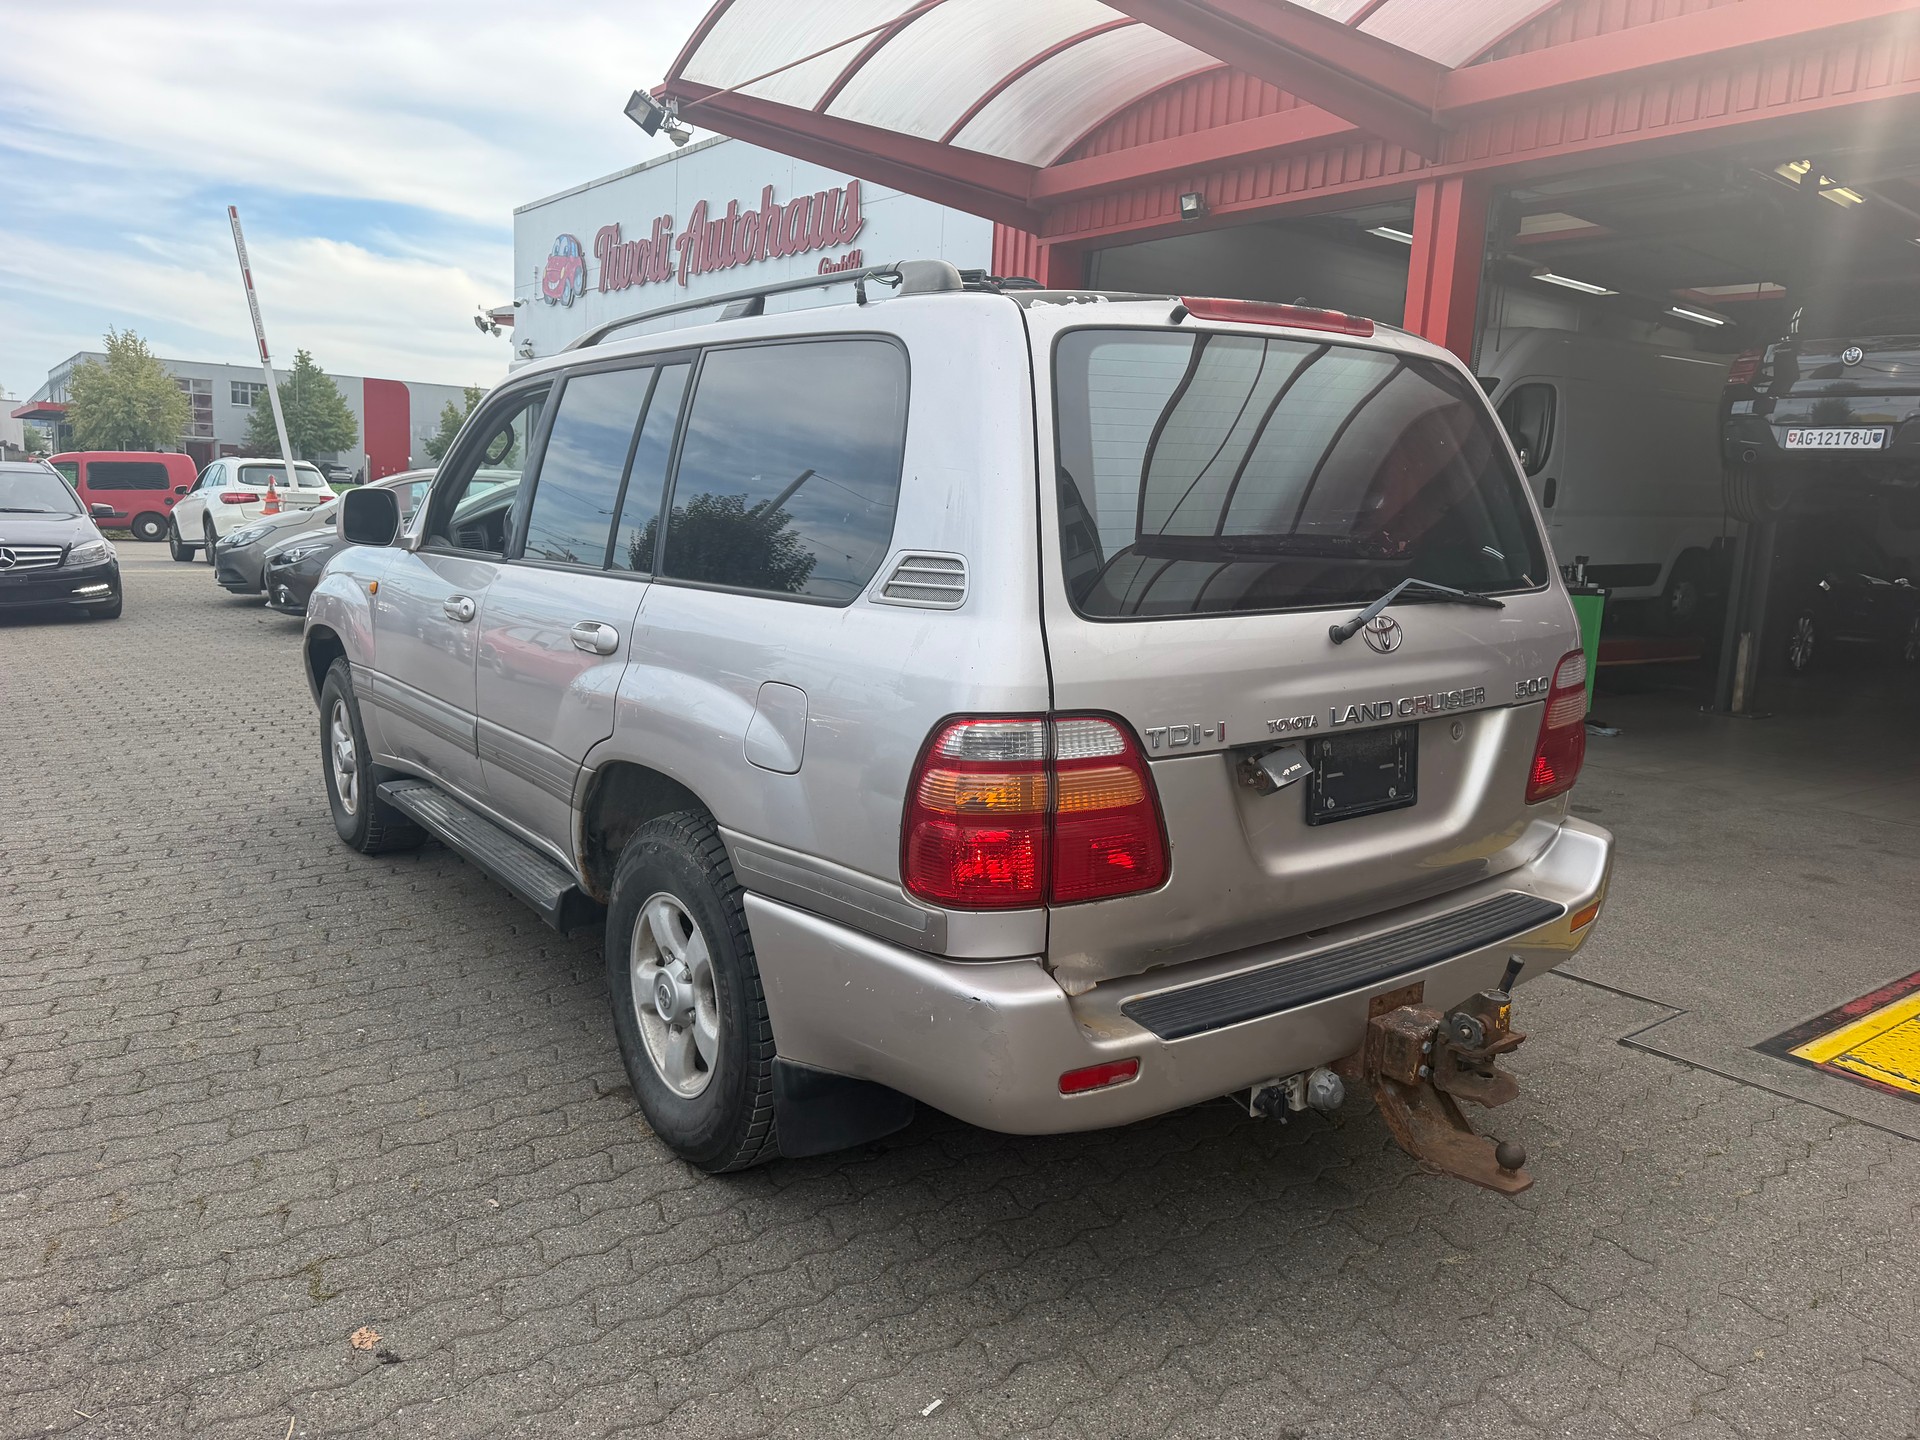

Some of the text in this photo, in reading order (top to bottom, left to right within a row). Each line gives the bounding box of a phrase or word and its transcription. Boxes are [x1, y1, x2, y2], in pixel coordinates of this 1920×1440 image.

[234, 220, 242, 237] AUTO
[238, 237, 246, 255] TIVOLI
[594, 179, 865, 293] Tivoli Autohaus
[818, 248, 862, 275] GmbH
[253, 307, 261, 325] TIVOLI
[1515, 676, 1549, 699] 500
[1267, 686, 1485, 733] TOYOTA LAND CRUISER
[1145, 720, 1225, 748] TDI-I
